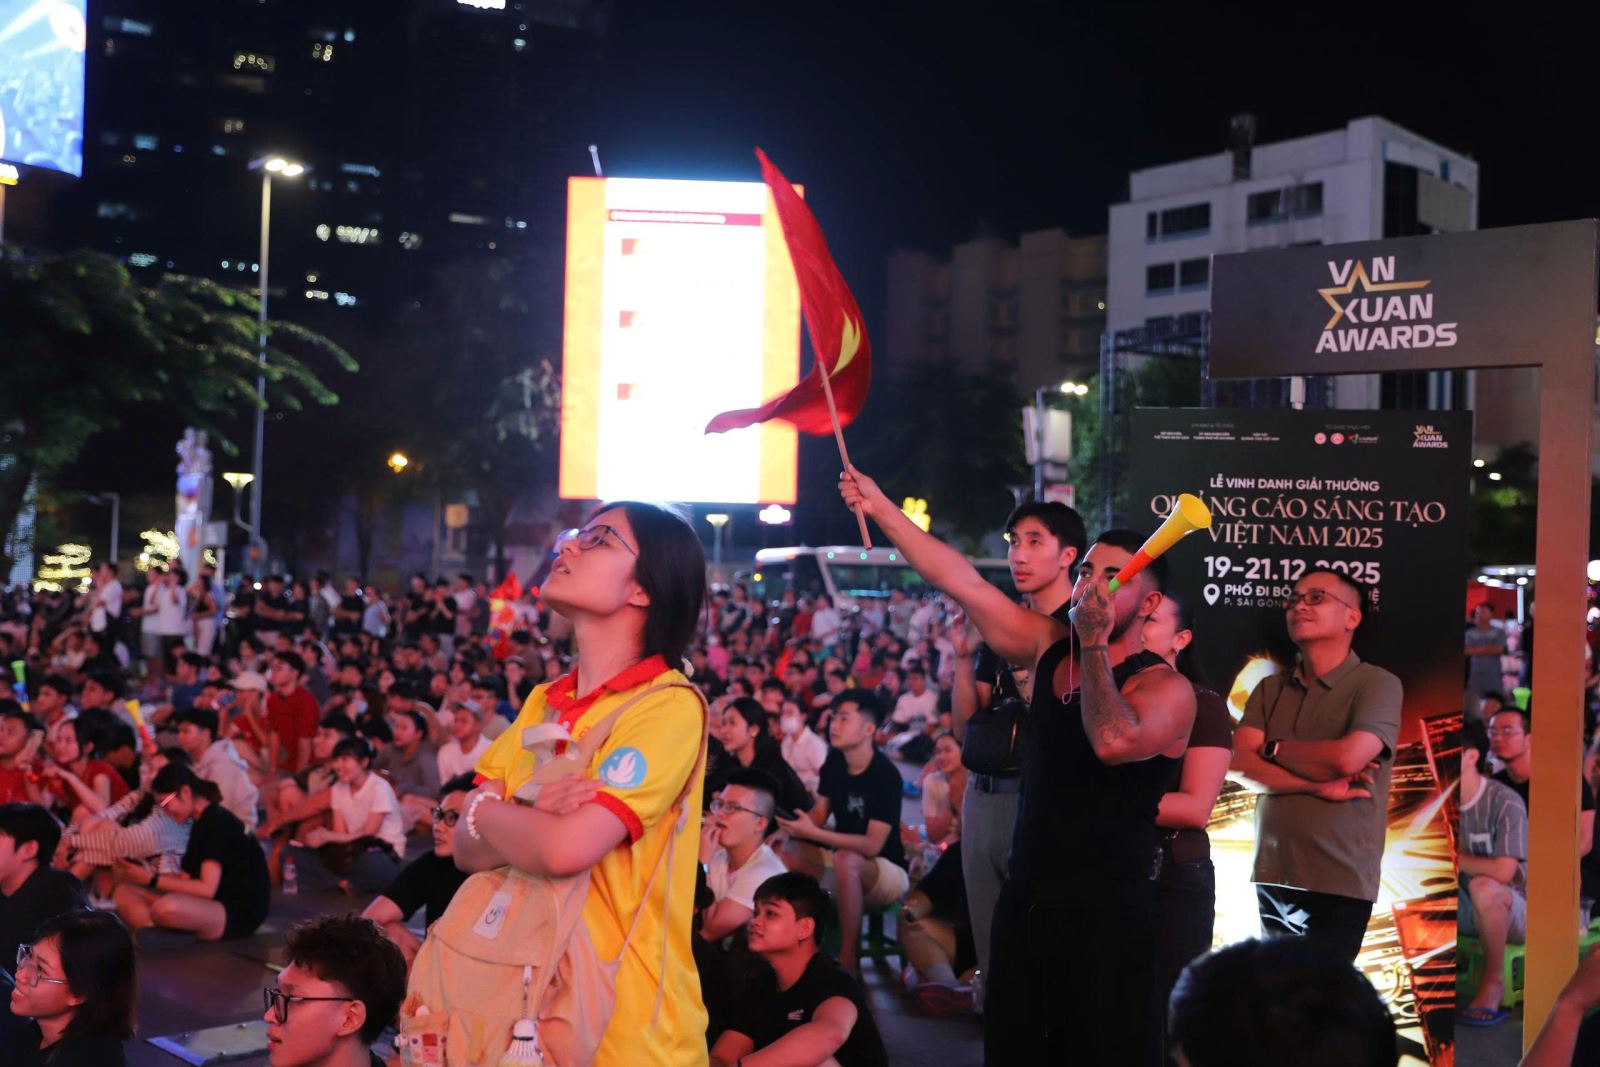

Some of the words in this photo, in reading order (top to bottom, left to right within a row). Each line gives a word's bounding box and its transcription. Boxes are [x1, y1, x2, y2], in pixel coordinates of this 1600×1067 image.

[1328, 256, 1396, 292] VAN
[1324, 293, 1434, 330] XUAN
[1315, 322, 1458, 354] AWARDS
[1226, 477, 1255, 489] VINH
[1258, 478, 1293, 490] DANH
[1296, 476, 1322, 491] GIẢI
[1150, 489, 1246, 520] QNG
[1251, 493, 1308, 519] CÁO
[1312, 494, 1384, 521] SÁNG
[1389, 500, 1446, 528] TẠO
[1208, 519, 1264, 549] VIỆT
[1268, 524, 1329, 546] NAM
[1334, 526, 1383, 548] 2025
[1203, 556, 1381, 584] 19-21.12025
[1224, 581, 1253, 596] PHỐ
[1256, 585, 1269, 597] ĐI
